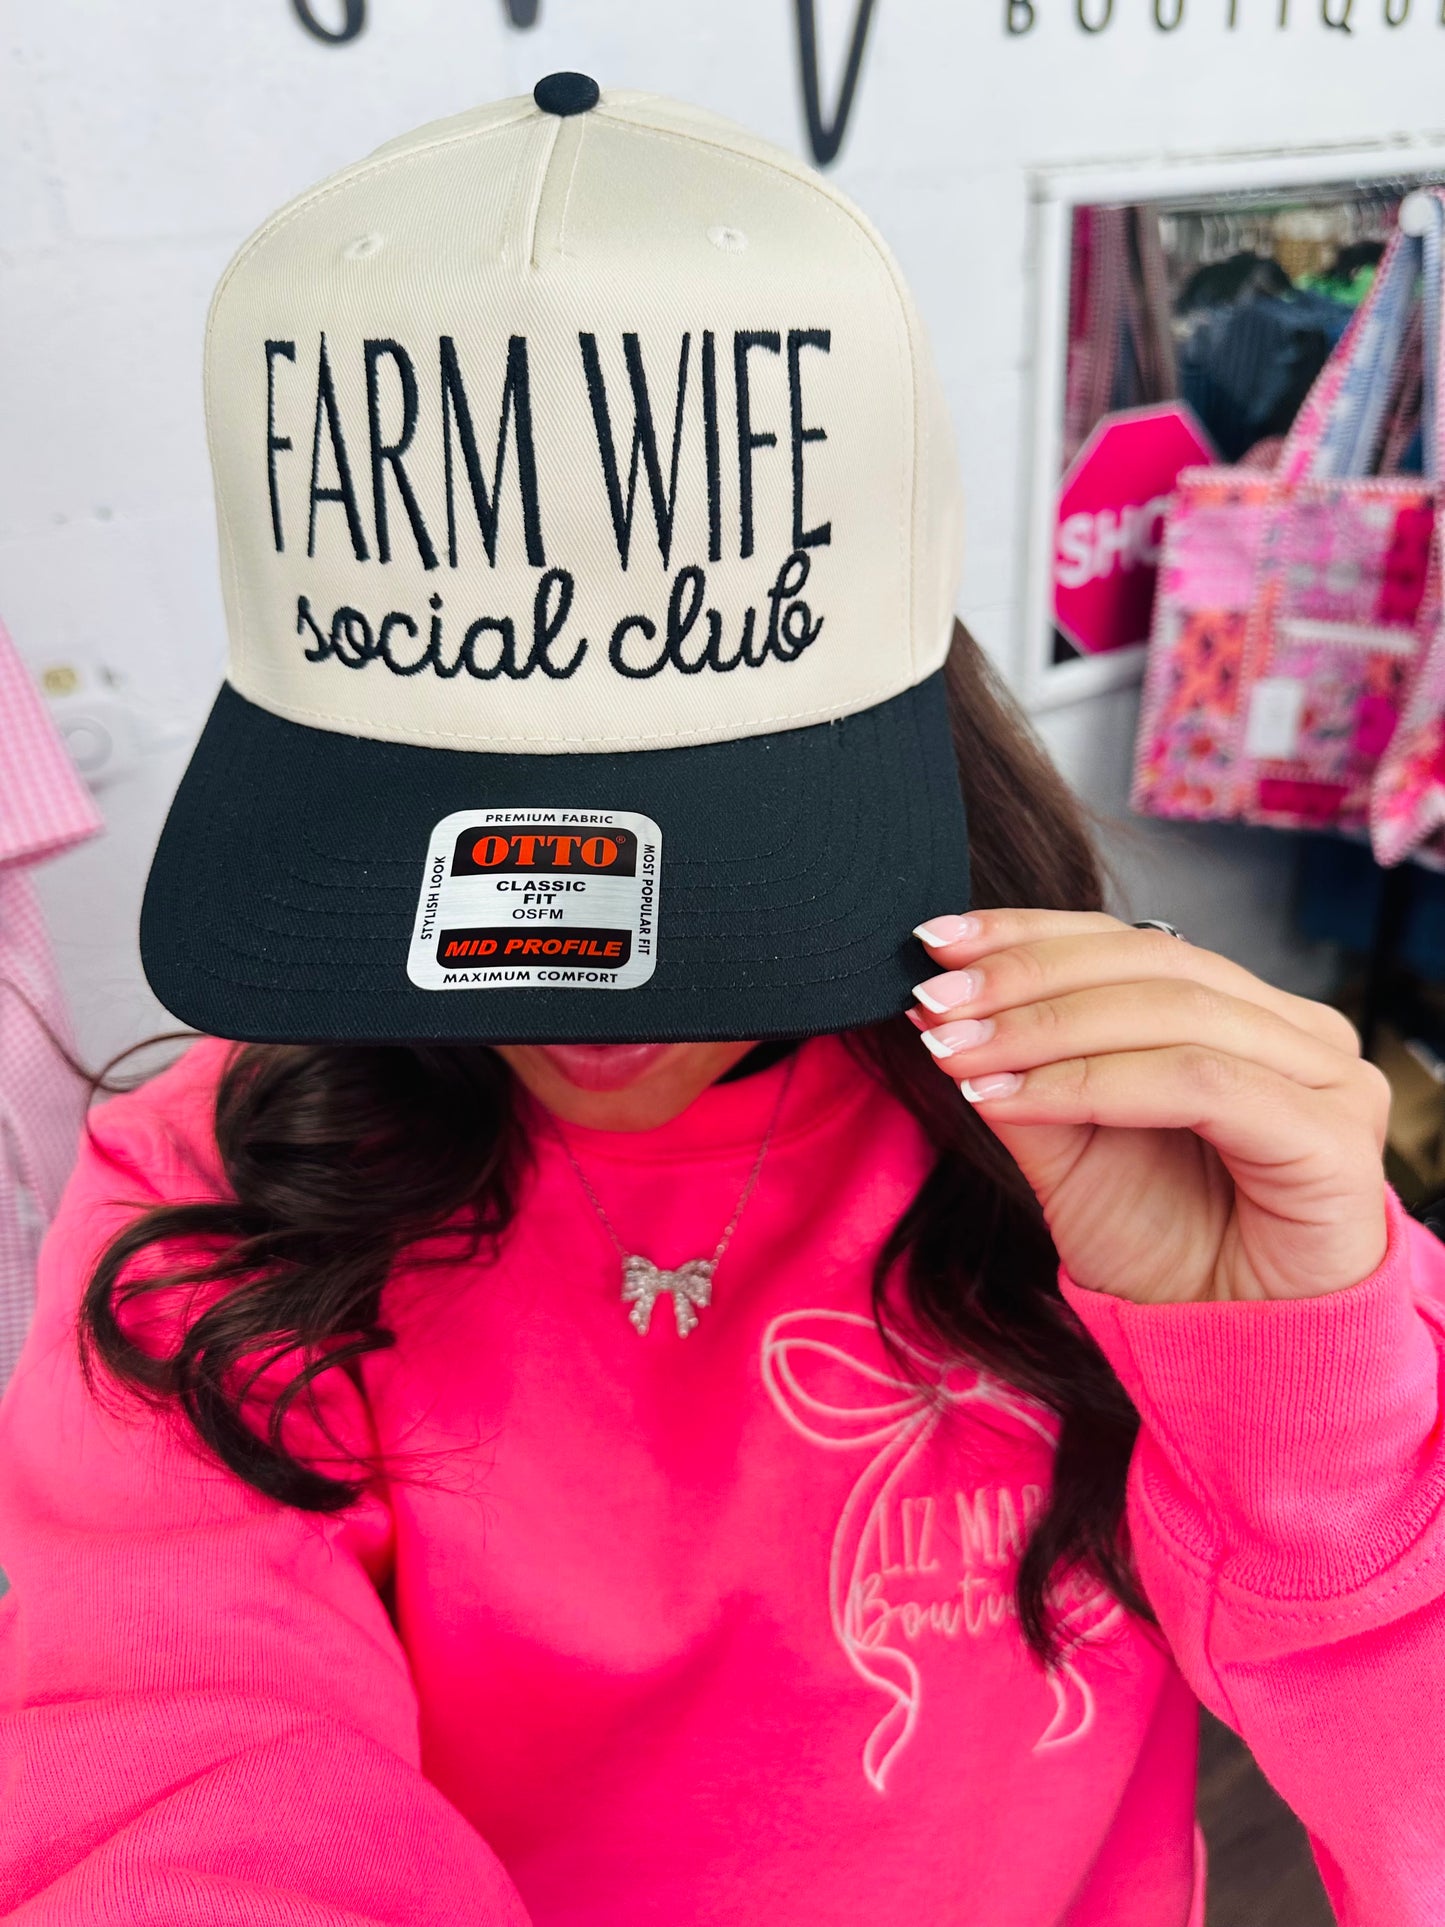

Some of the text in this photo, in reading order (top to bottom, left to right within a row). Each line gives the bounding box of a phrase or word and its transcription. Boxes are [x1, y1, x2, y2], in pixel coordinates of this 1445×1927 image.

[1006, 0, 1445, 35] BOUIQU
[265, 329, 831, 571] FARM WIFE
[1054, 494, 1167, 589] SHO
[298, 550, 825, 680] social club
[485, 813, 614, 824] PREMIUM FABRIC
[421, 856, 446, 940] STYLISH LOOK
[496, 880, 587, 892] CLASSIC
[523, 893, 557, 905] FIT
[638, 844, 655, 955] MOST POPULAR FIT
[512, 908, 564, 920] OSFM
[444, 938, 623, 958] MID PROFILE
[443, 971, 618, 984] MAXIMUM COMFORT
[877, 1496, 941, 1575] LIZ
